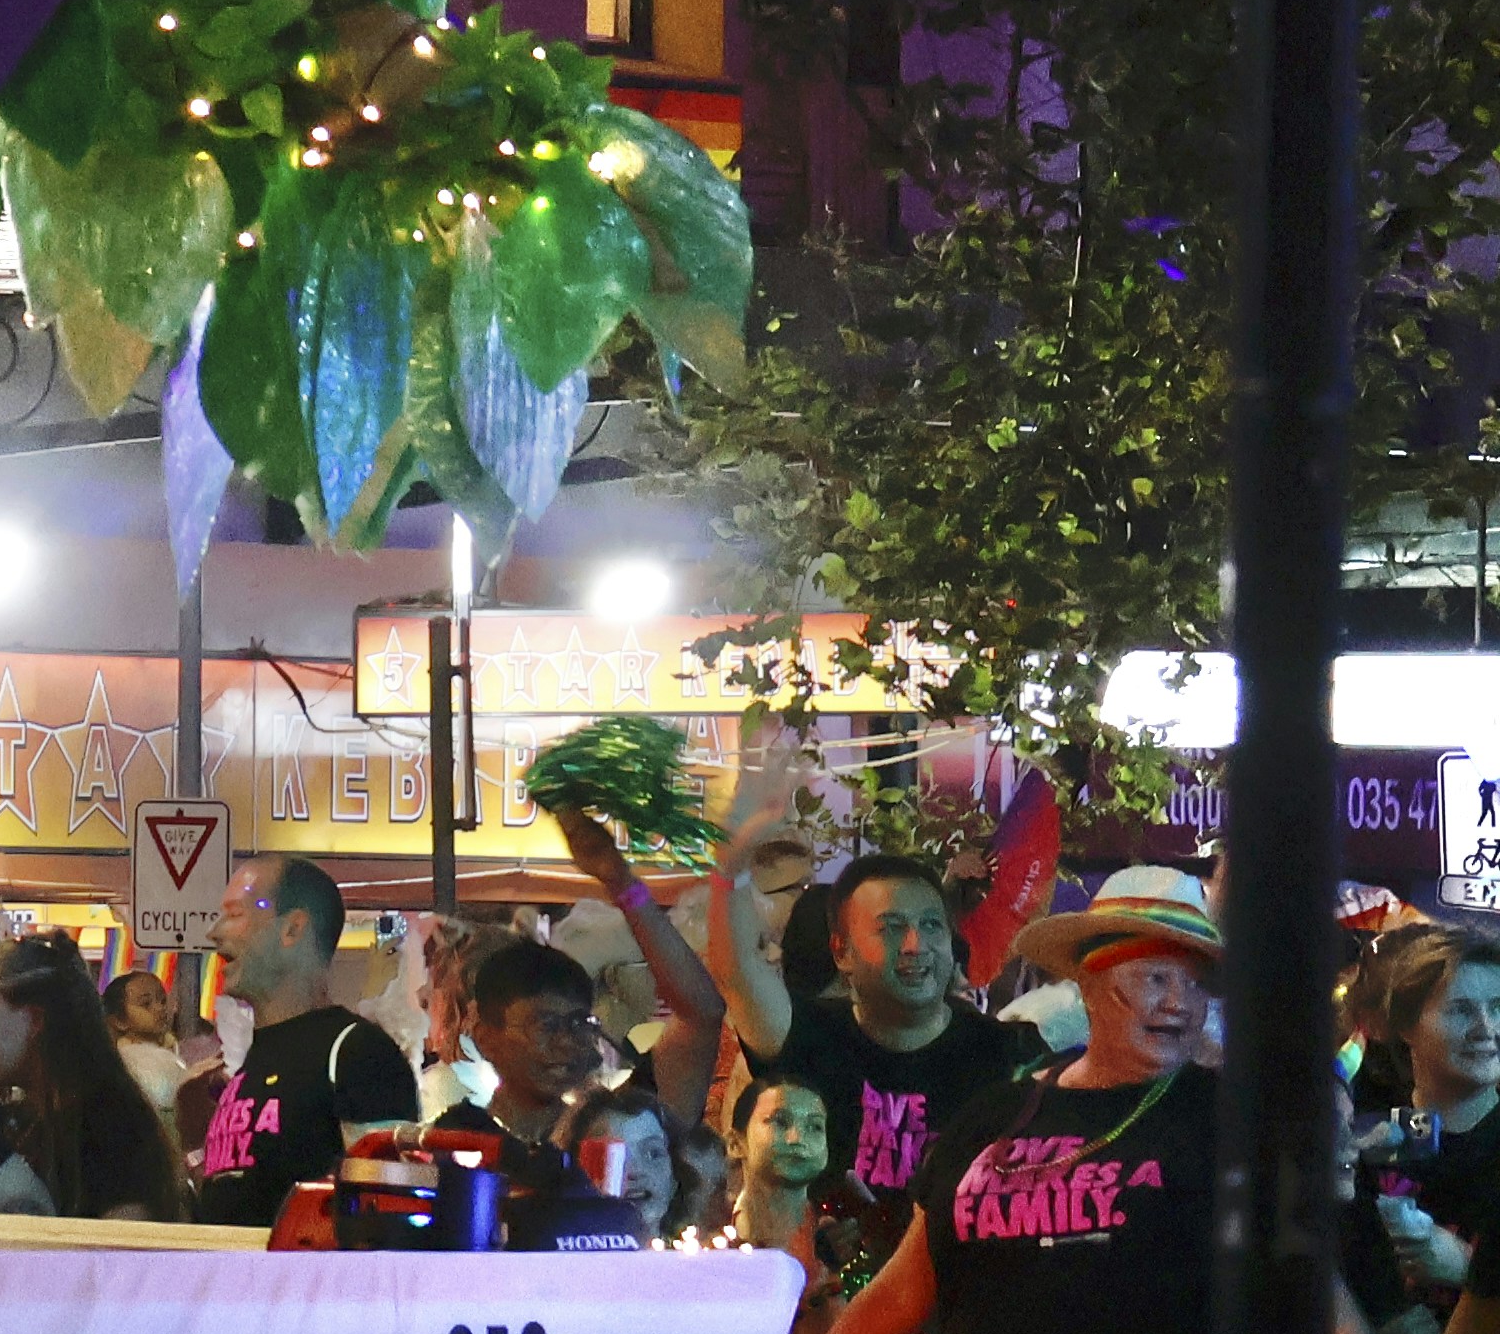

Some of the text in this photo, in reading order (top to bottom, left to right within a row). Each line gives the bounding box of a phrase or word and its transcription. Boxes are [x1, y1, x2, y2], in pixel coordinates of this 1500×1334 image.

[383, 652, 404, 692] 5
[164, 829, 198, 844] GIVE
[1127, 1159, 1163, 1188] A
[954, 1187, 1127, 1242] FAMILY.
[556, 1233, 640, 1251] HONDA
